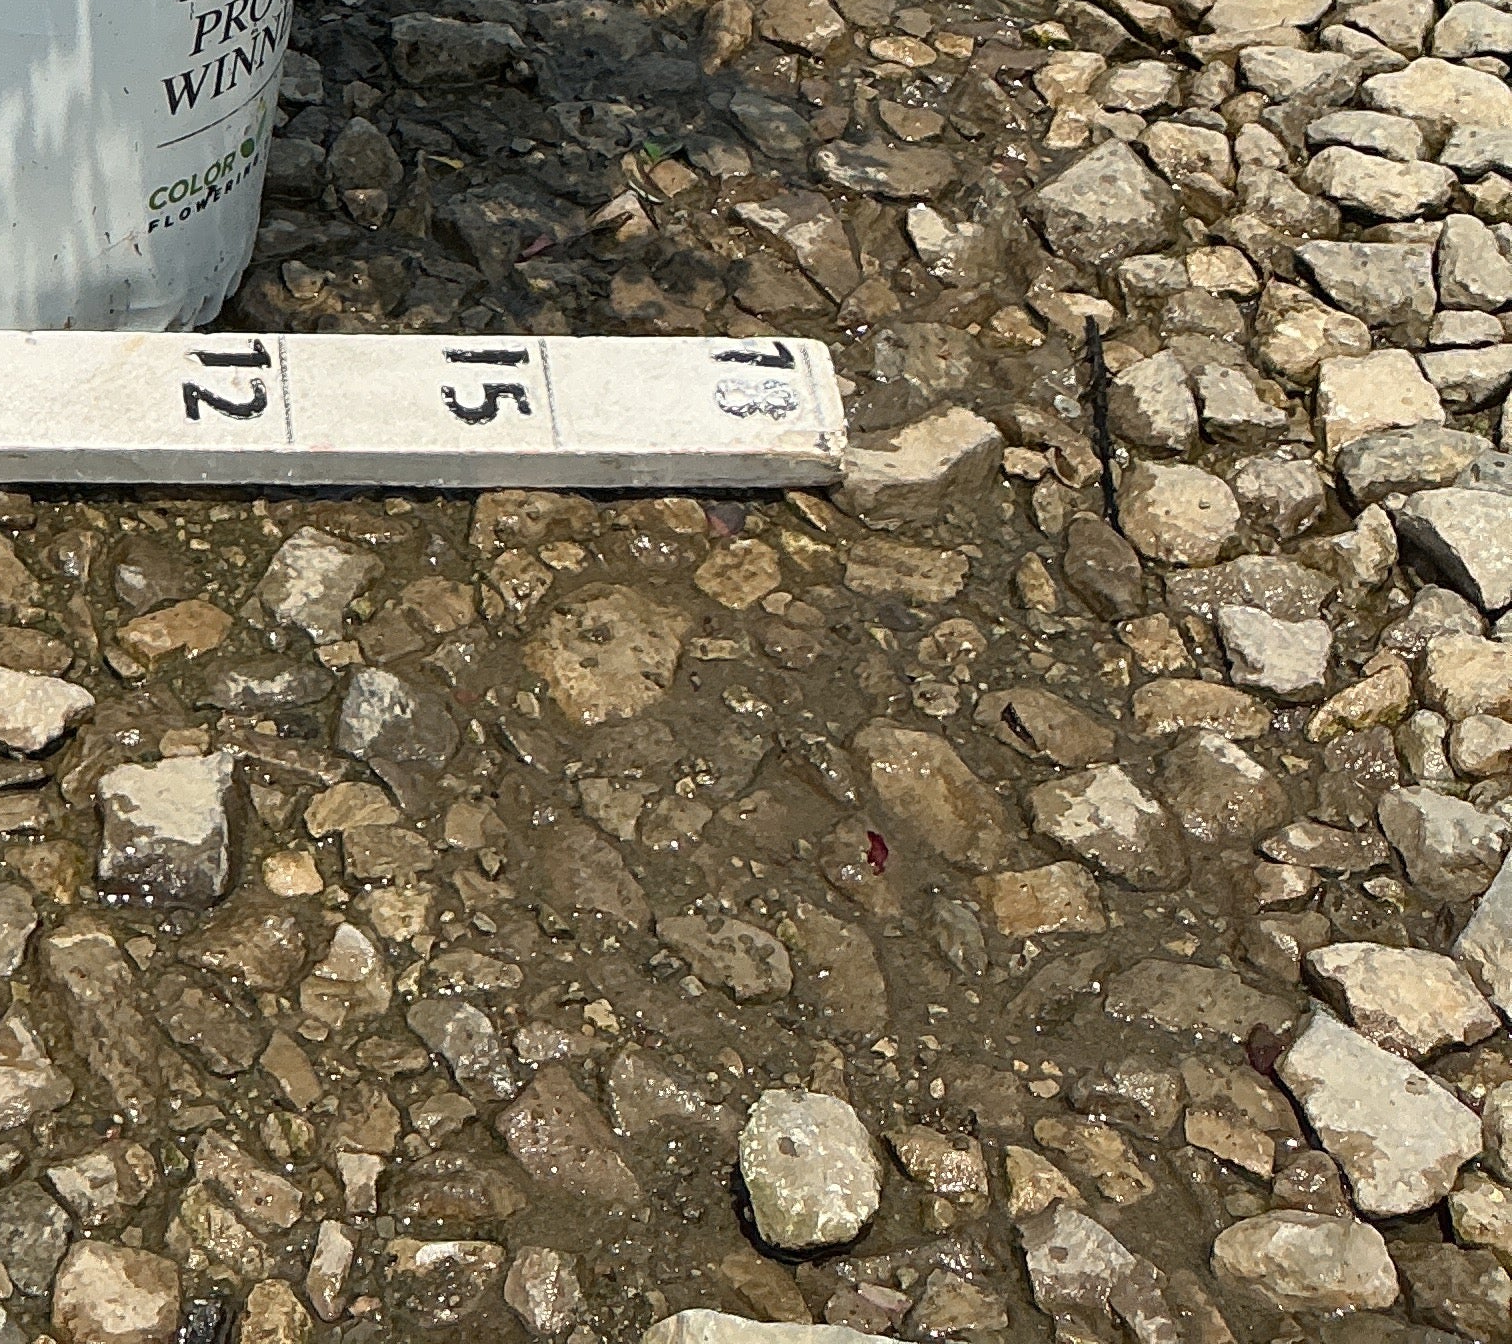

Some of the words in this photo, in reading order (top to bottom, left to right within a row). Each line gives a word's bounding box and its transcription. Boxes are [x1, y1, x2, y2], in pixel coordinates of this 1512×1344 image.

[148, 149, 237, 211] COLOR
[181, 338, 272, 421] 12
[440, 345, 532, 425] 15
[711, 340, 800, 418] 18
